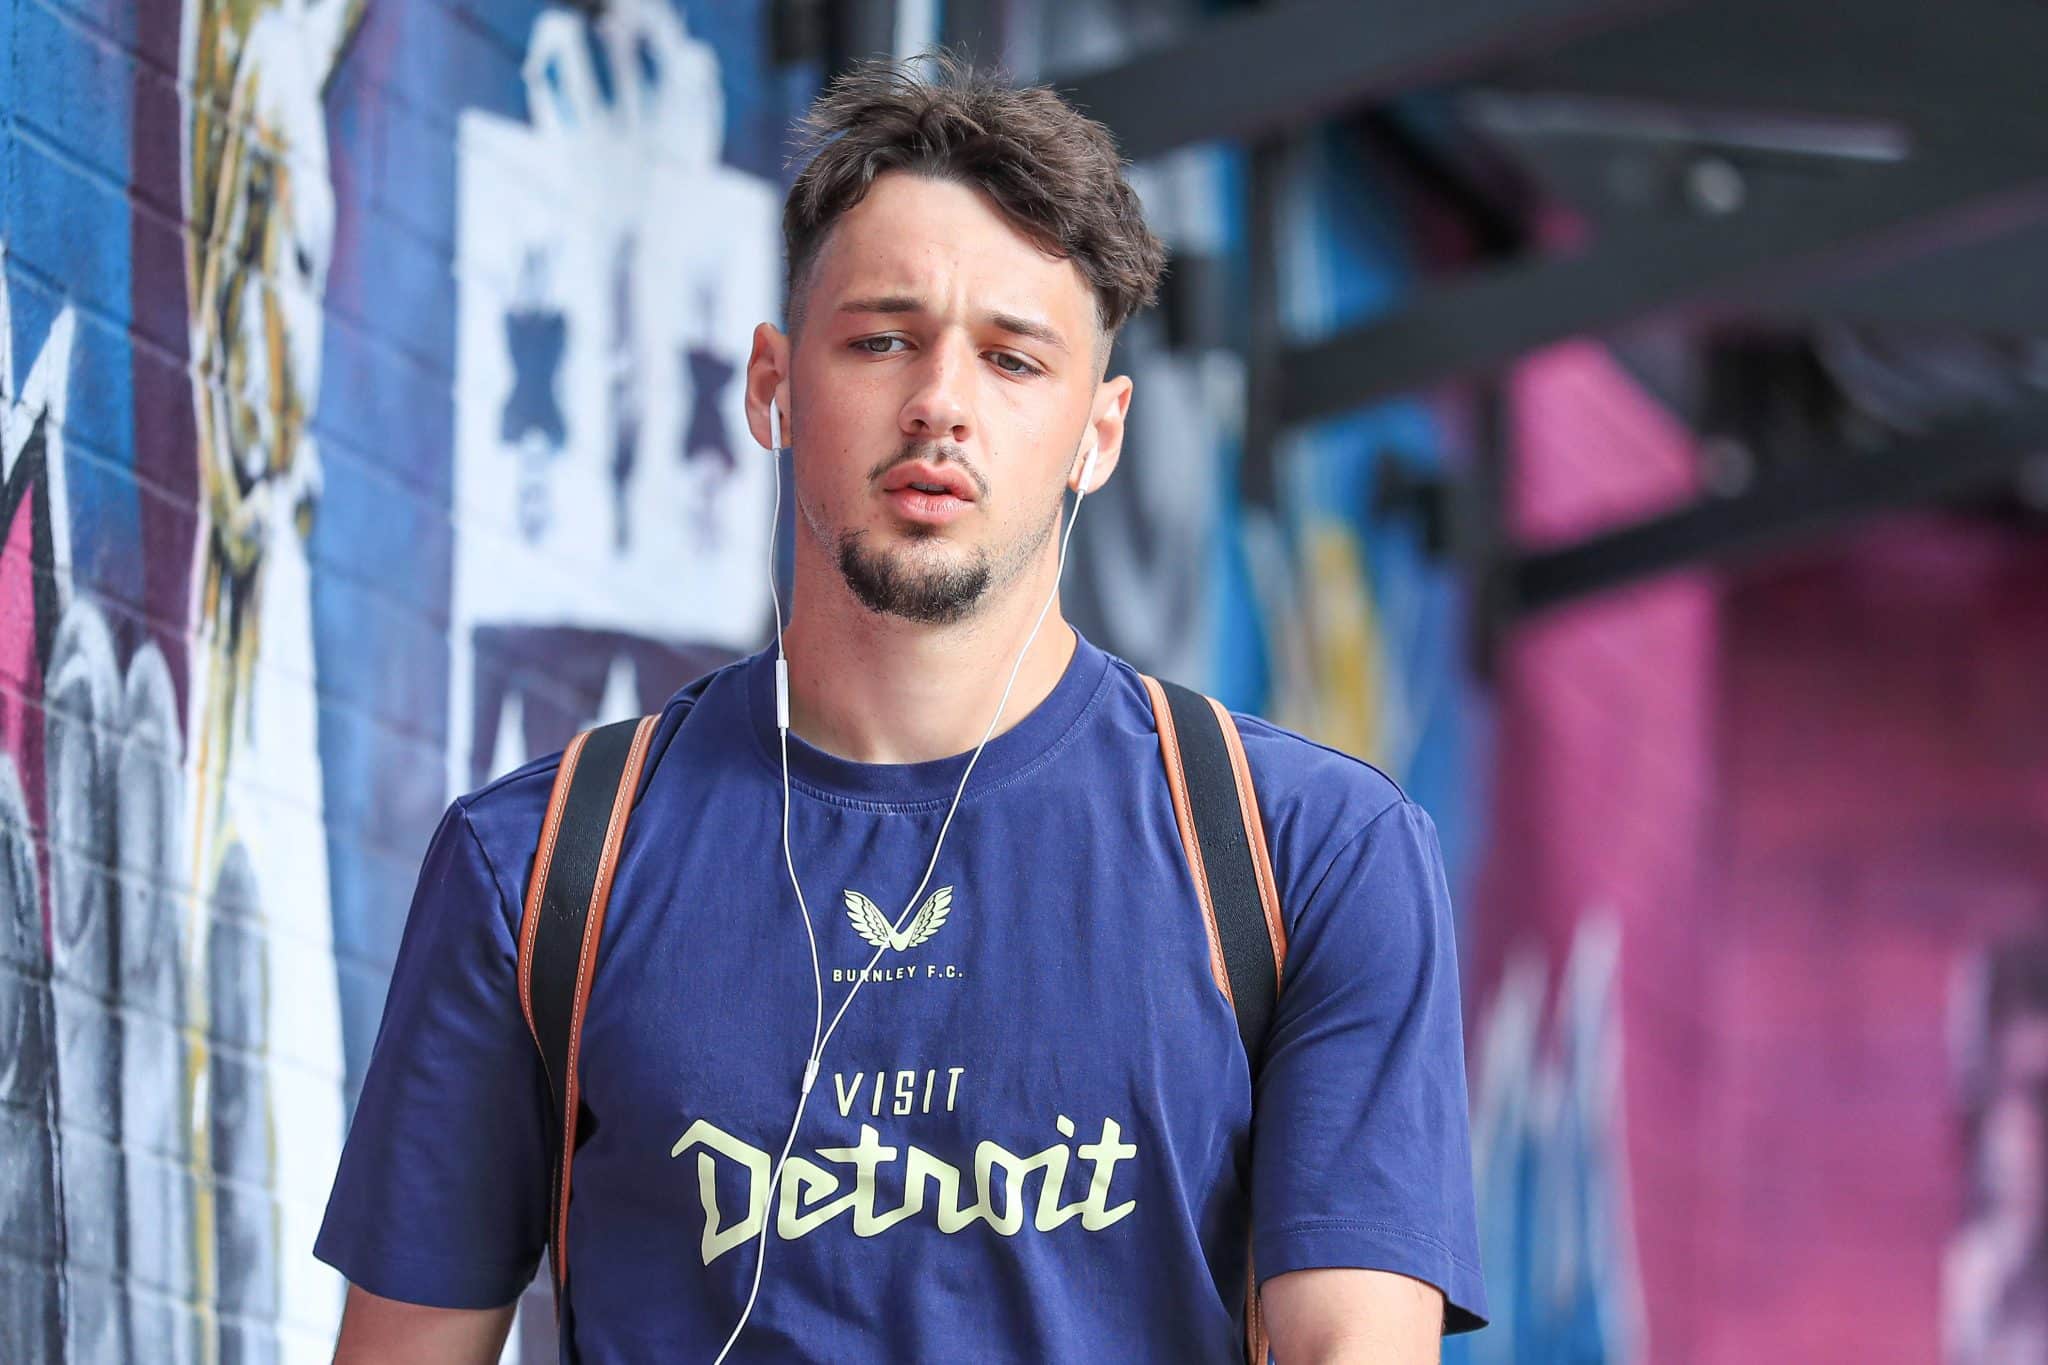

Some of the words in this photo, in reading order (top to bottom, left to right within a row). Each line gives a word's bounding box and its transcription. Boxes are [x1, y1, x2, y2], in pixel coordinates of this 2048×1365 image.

[927, 965, 963, 978] F.C.
[834, 1068, 964, 1117] VISIT
[671, 1115, 1137, 1266] Detroit
